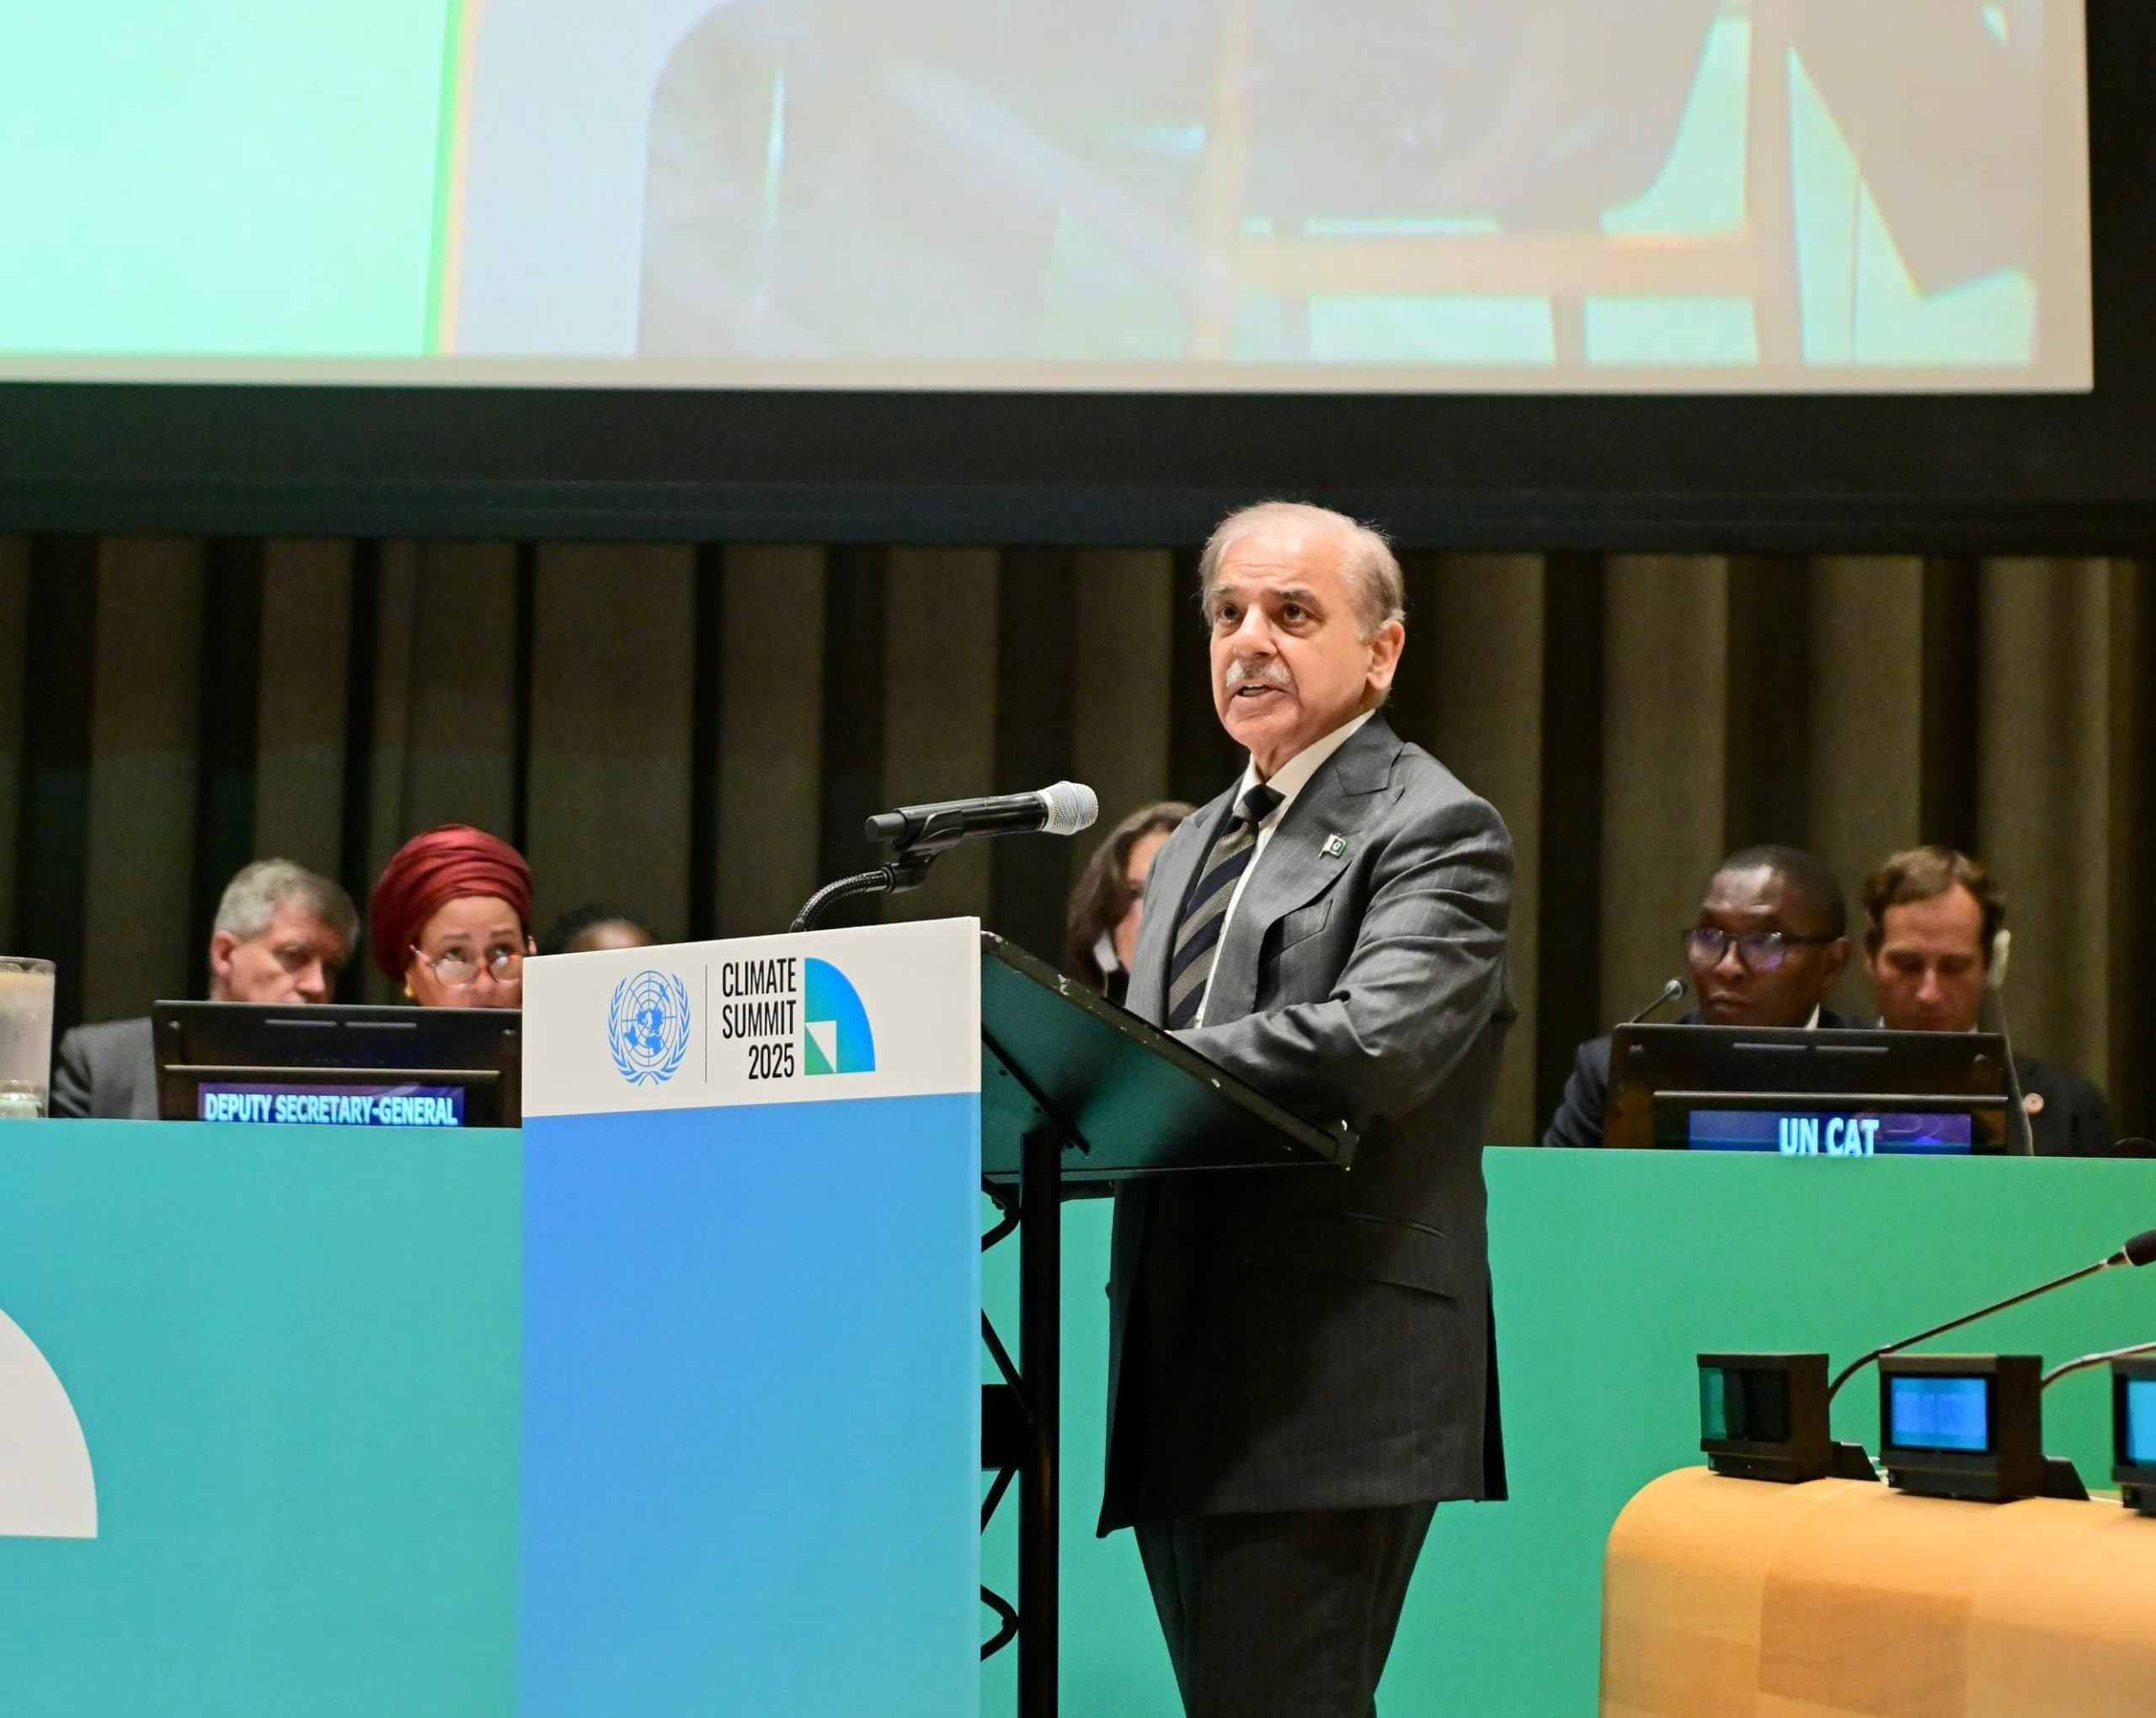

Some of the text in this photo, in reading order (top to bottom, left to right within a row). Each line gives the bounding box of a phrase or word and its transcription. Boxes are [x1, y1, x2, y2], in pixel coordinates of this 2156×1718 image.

[722, 957, 797, 997] CLIMATE
[722, 1000, 797, 1039] SUMMIT
[748, 1043, 794, 1080] 2025
[204, 1093, 458, 1126] DEPUTY SECRETARY-GENERAL
[1778, 1117, 1880, 1157] UN CAT
